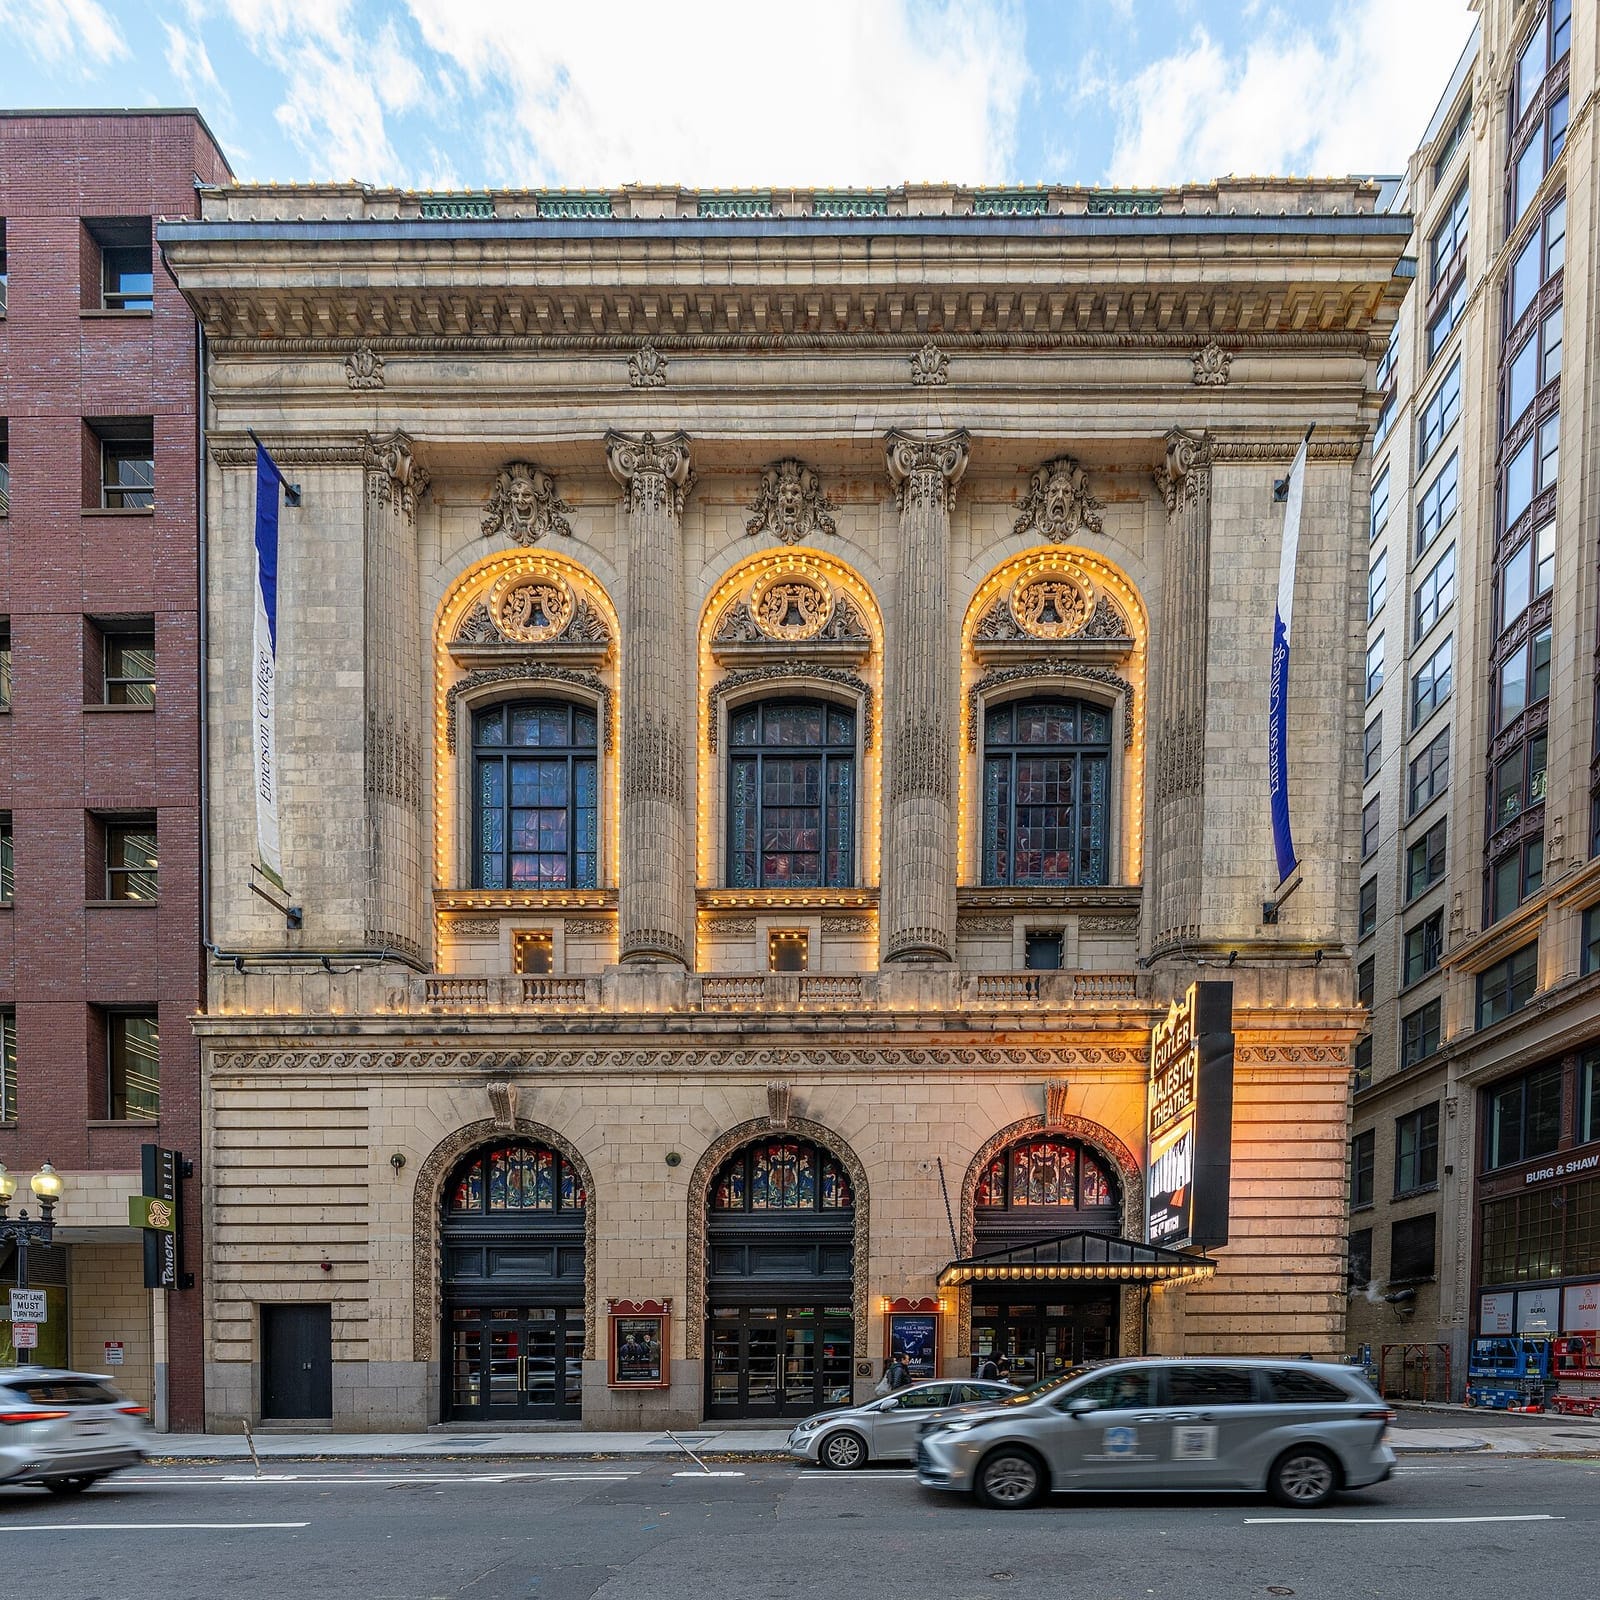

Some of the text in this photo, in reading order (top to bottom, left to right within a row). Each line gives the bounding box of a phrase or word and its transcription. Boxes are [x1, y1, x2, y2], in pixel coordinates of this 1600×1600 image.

[257, 651, 274, 804] Emerson College
[1155, 1021, 1189, 1070] CUTLER
[1151, 1050, 1195, 1107] MAJESTIC
[1153, 1083, 1191, 1129] THEATRE
[1526, 1155, 1600, 1183] BURG & SHAW
[162, 1152, 174, 1285] Panera BREAD
[909, 1357, 922, 1365] AM
